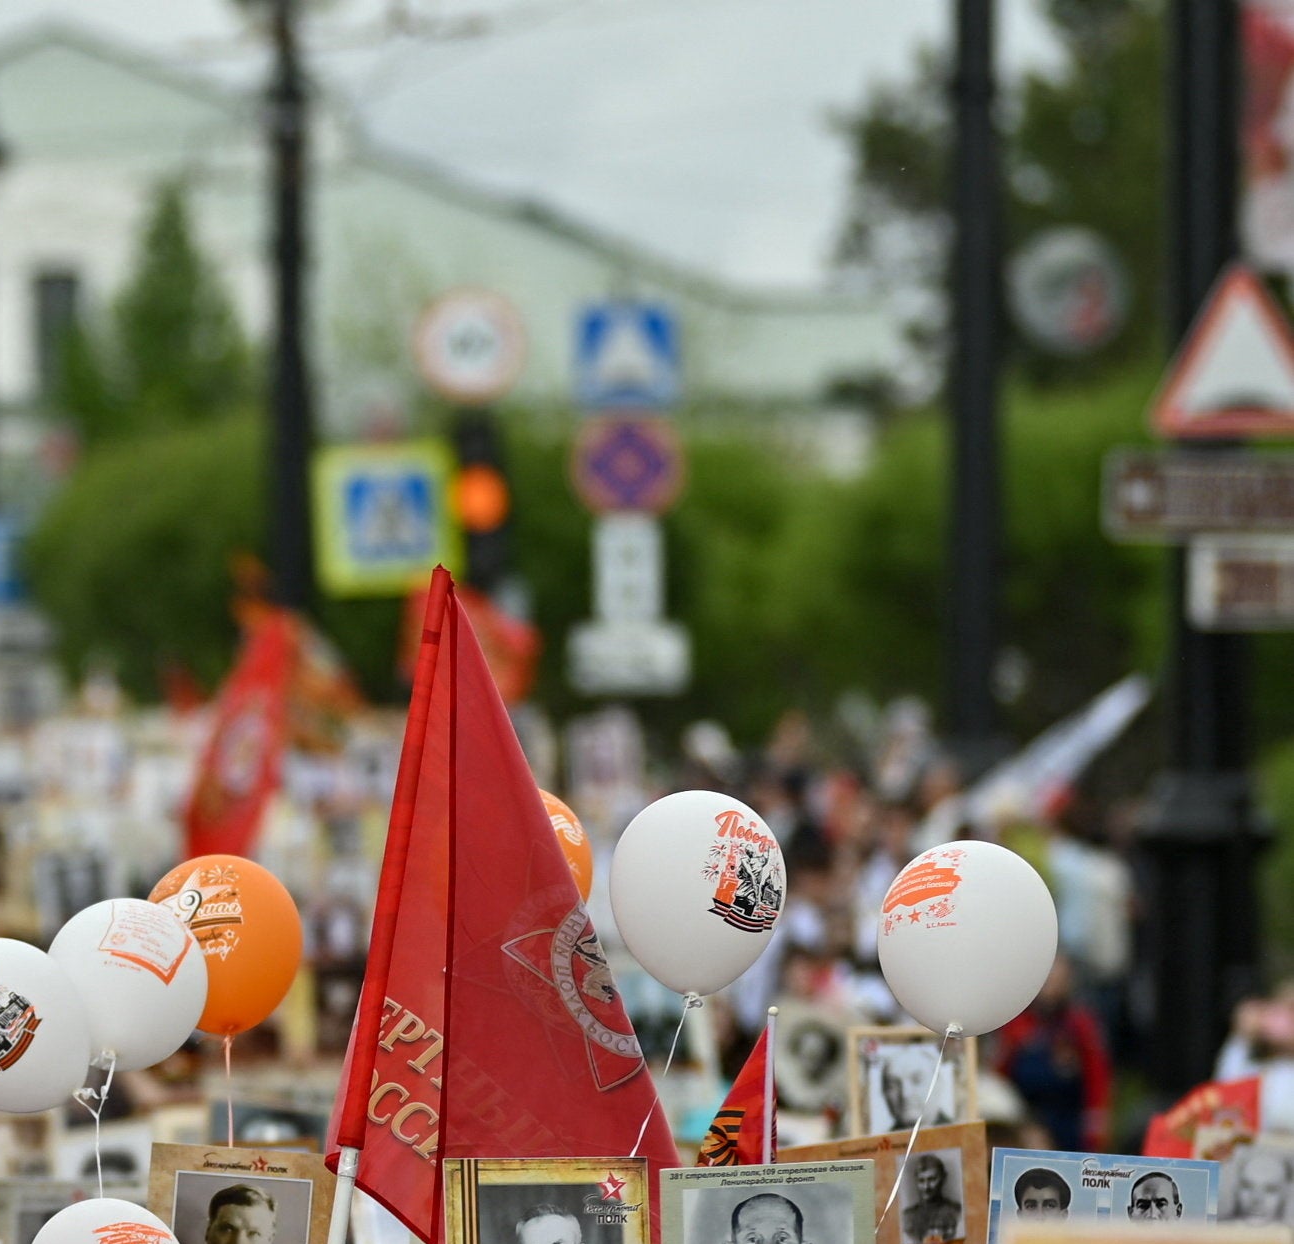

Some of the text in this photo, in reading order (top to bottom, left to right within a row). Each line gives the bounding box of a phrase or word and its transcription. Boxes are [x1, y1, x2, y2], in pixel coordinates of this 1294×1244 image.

[670, 1172, 684, 1180] 381
[685, 1169, 738, 1180] стрелковый
[777, 1165, 827, 1176] стрелковая
[720, 1174, 815, 1187] Ленинградский фронт
[1082, 1177, 1111, 1188] ПОЛК
[597, 1214, 628, 1224] ПОЛК
